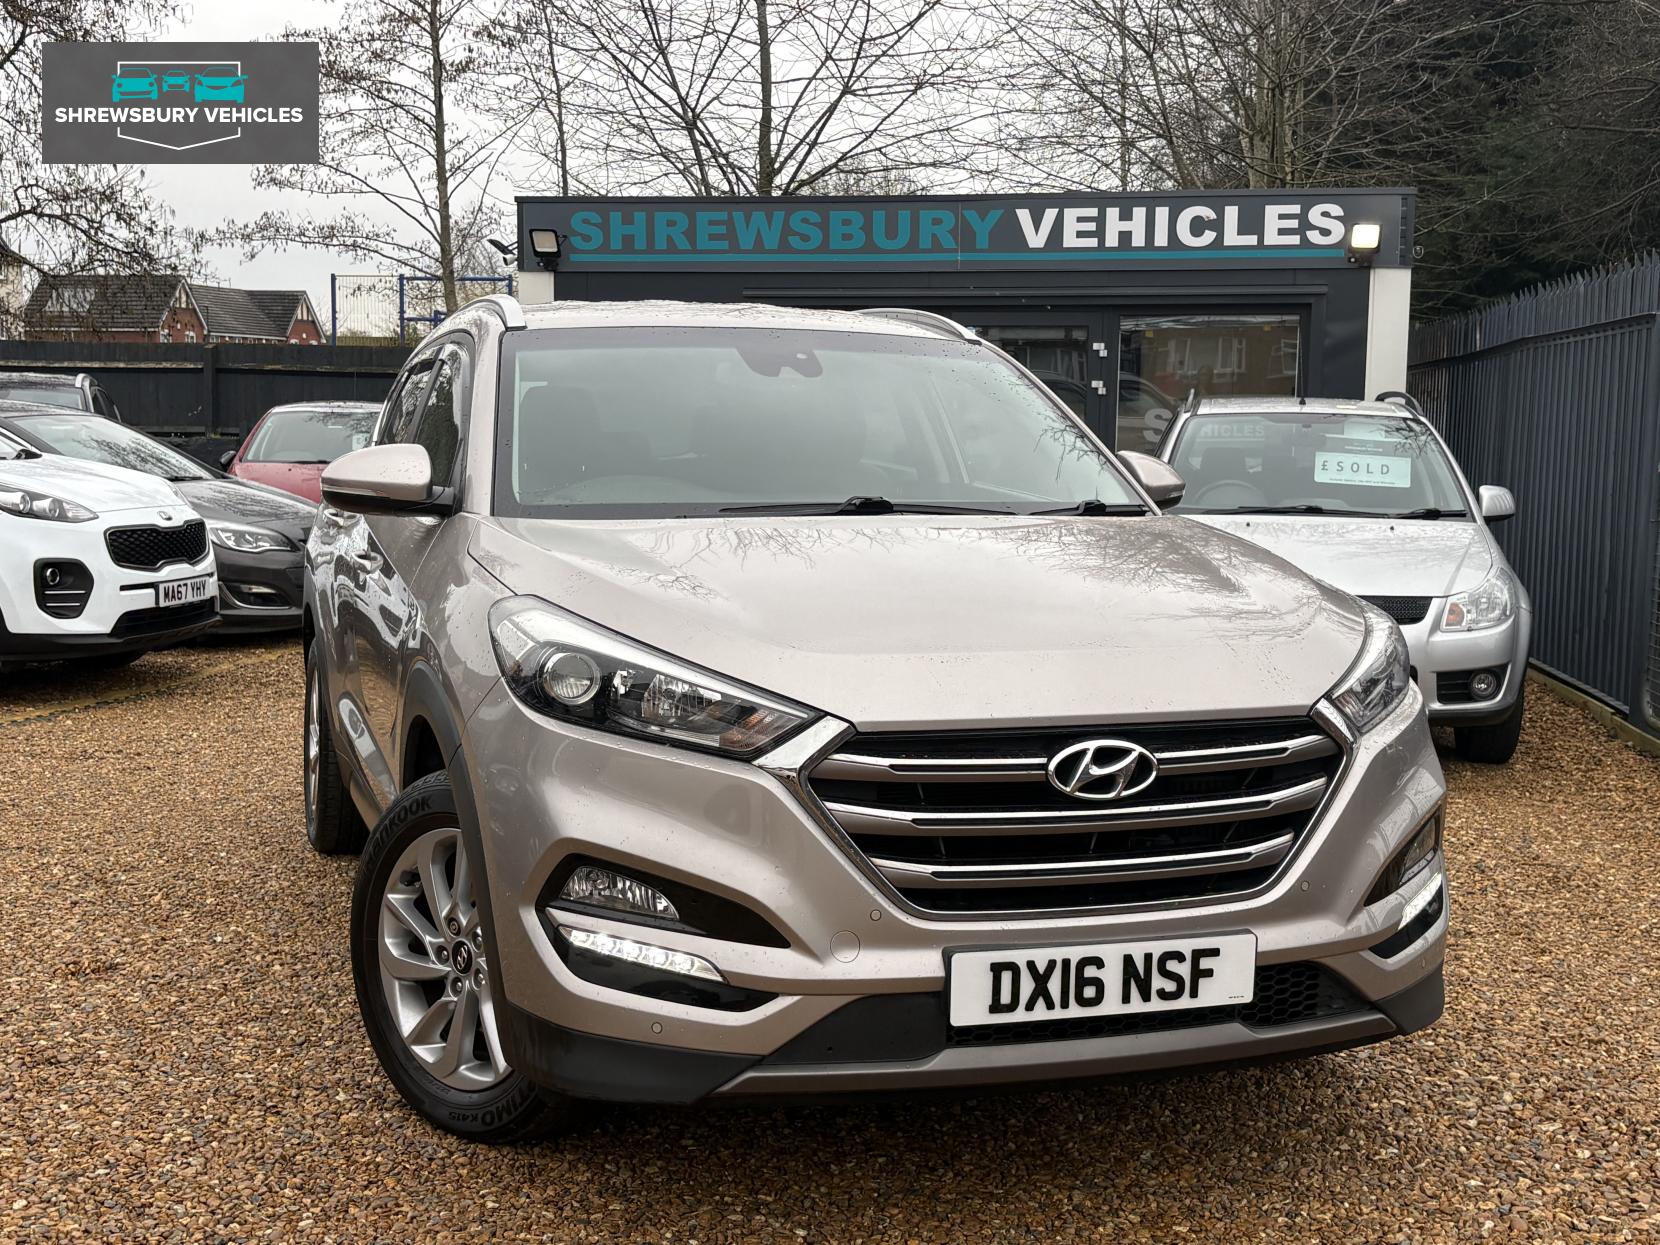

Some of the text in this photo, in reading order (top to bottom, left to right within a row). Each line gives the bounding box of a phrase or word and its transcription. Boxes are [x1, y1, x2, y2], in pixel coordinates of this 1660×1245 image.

[569, 203, 1345, 251] SHREWSBURY VEHICLES
[163, 580, 207, 603] MA67 YHY
[989, 947, 1221, 1014] DX16 NSF
